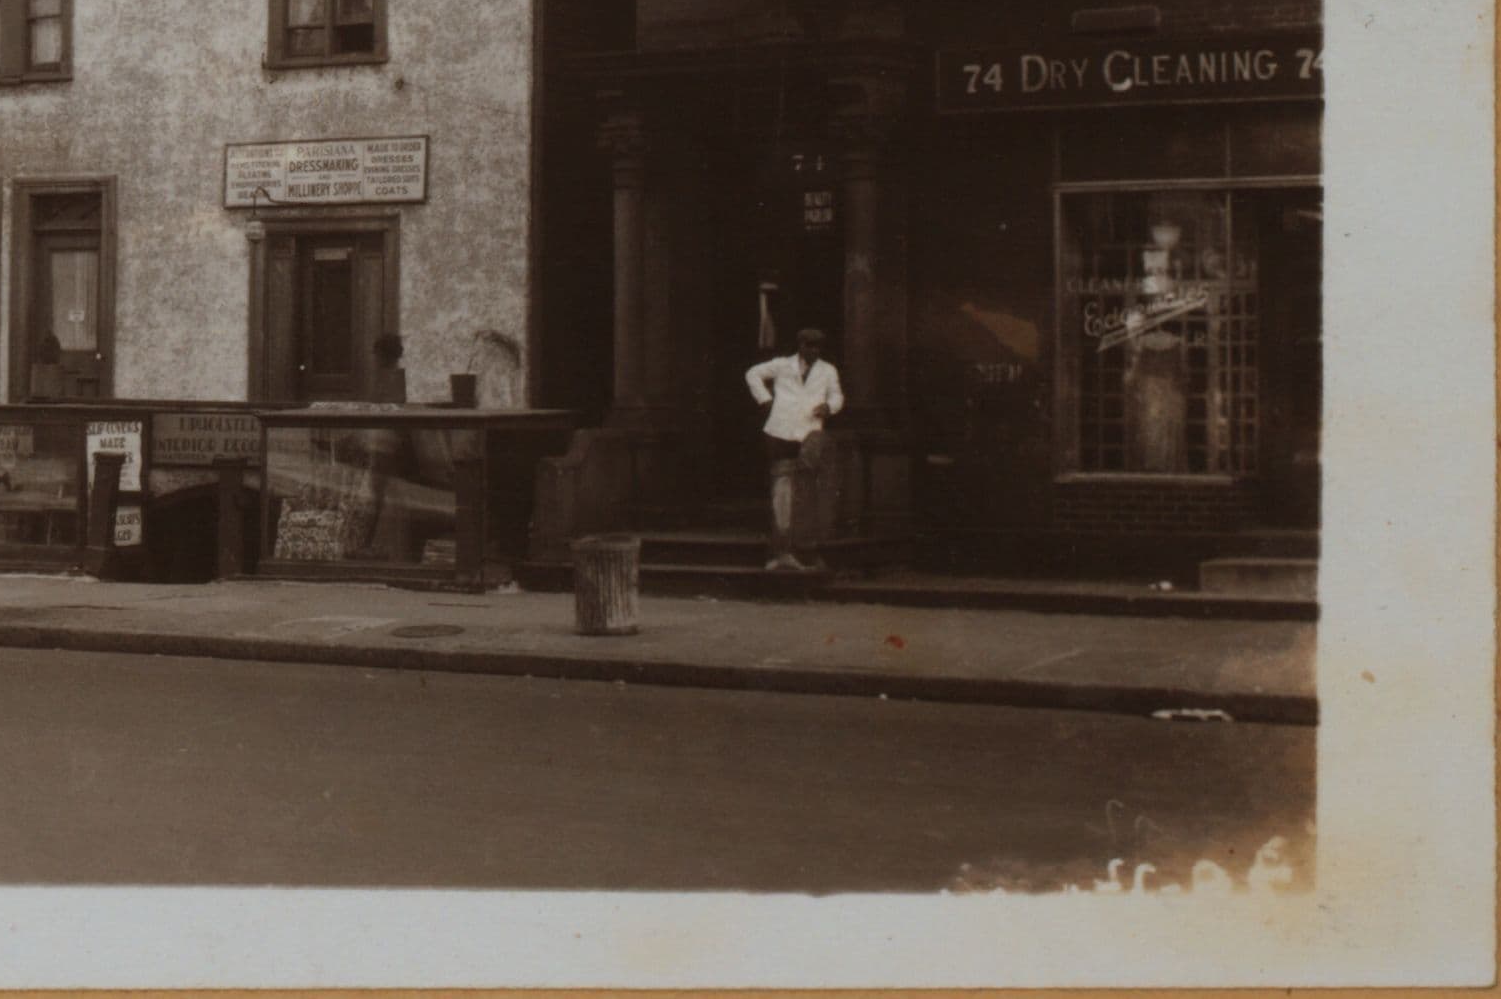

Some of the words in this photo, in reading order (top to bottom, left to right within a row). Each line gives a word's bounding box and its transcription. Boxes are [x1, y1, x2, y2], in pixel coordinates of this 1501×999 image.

[963, 63, 1004, 93] 74
[1019, 54, 1089, 93] DRY
[1102, 49, 1278, 91] CLEANING
[289, 158, 359, 173] DRESSMAKING
[288, 183, 331, 197] MILLINERY
[375, 185, 409, 195] COATS
[100, 437, 126, 449] MADE
